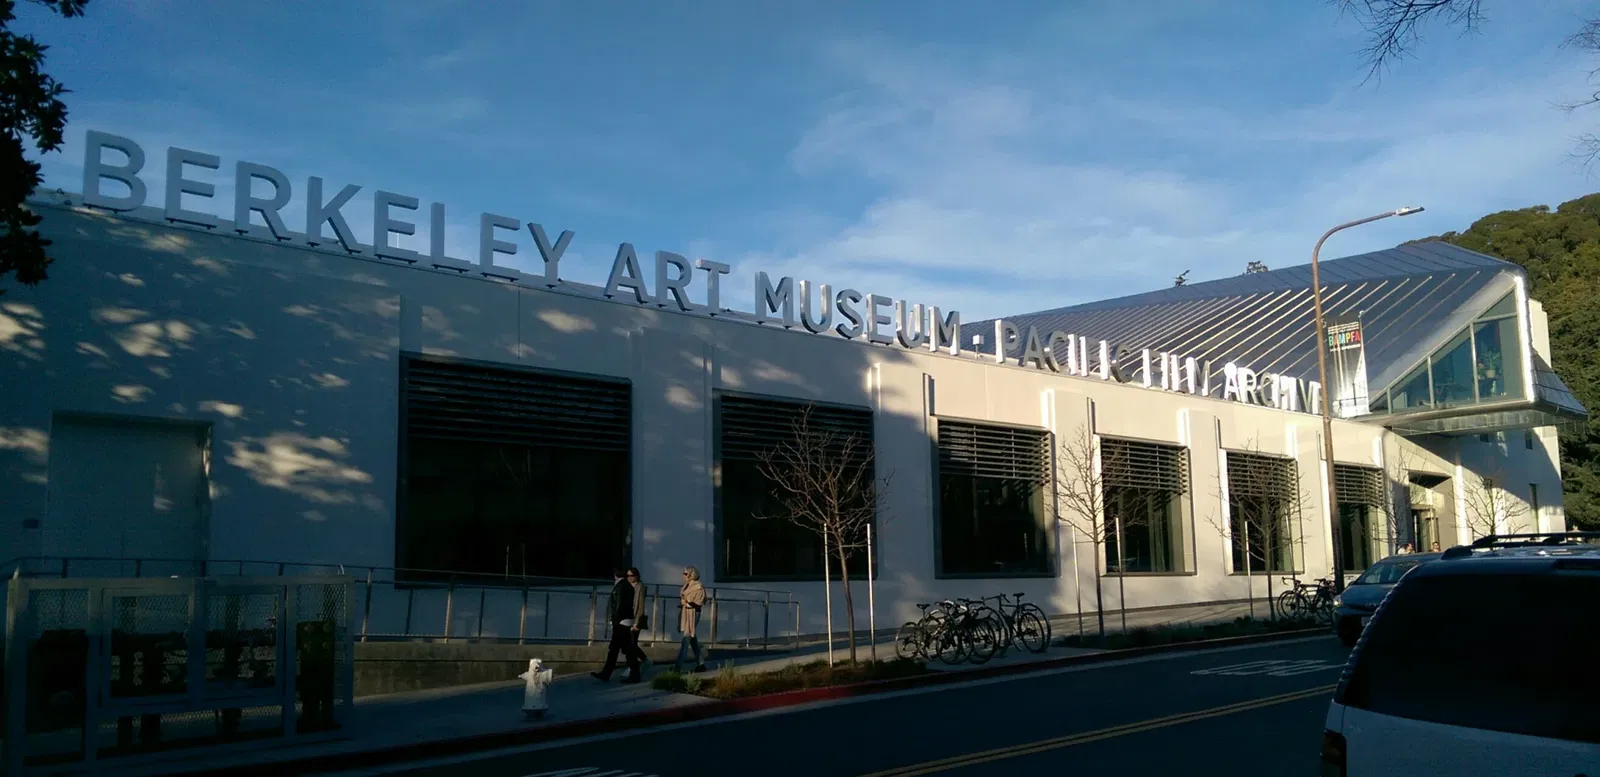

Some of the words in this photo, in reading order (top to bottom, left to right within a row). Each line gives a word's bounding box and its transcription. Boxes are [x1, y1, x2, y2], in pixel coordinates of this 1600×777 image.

[82, 129, 576, 287] BERKELEY
[603, 242, 730, 314] ART
[755, 271, 960, 355] MUSEUM
[995, 319, 1134, 383] PACIFIC
[1142, 348, 1210, 397] FILM
